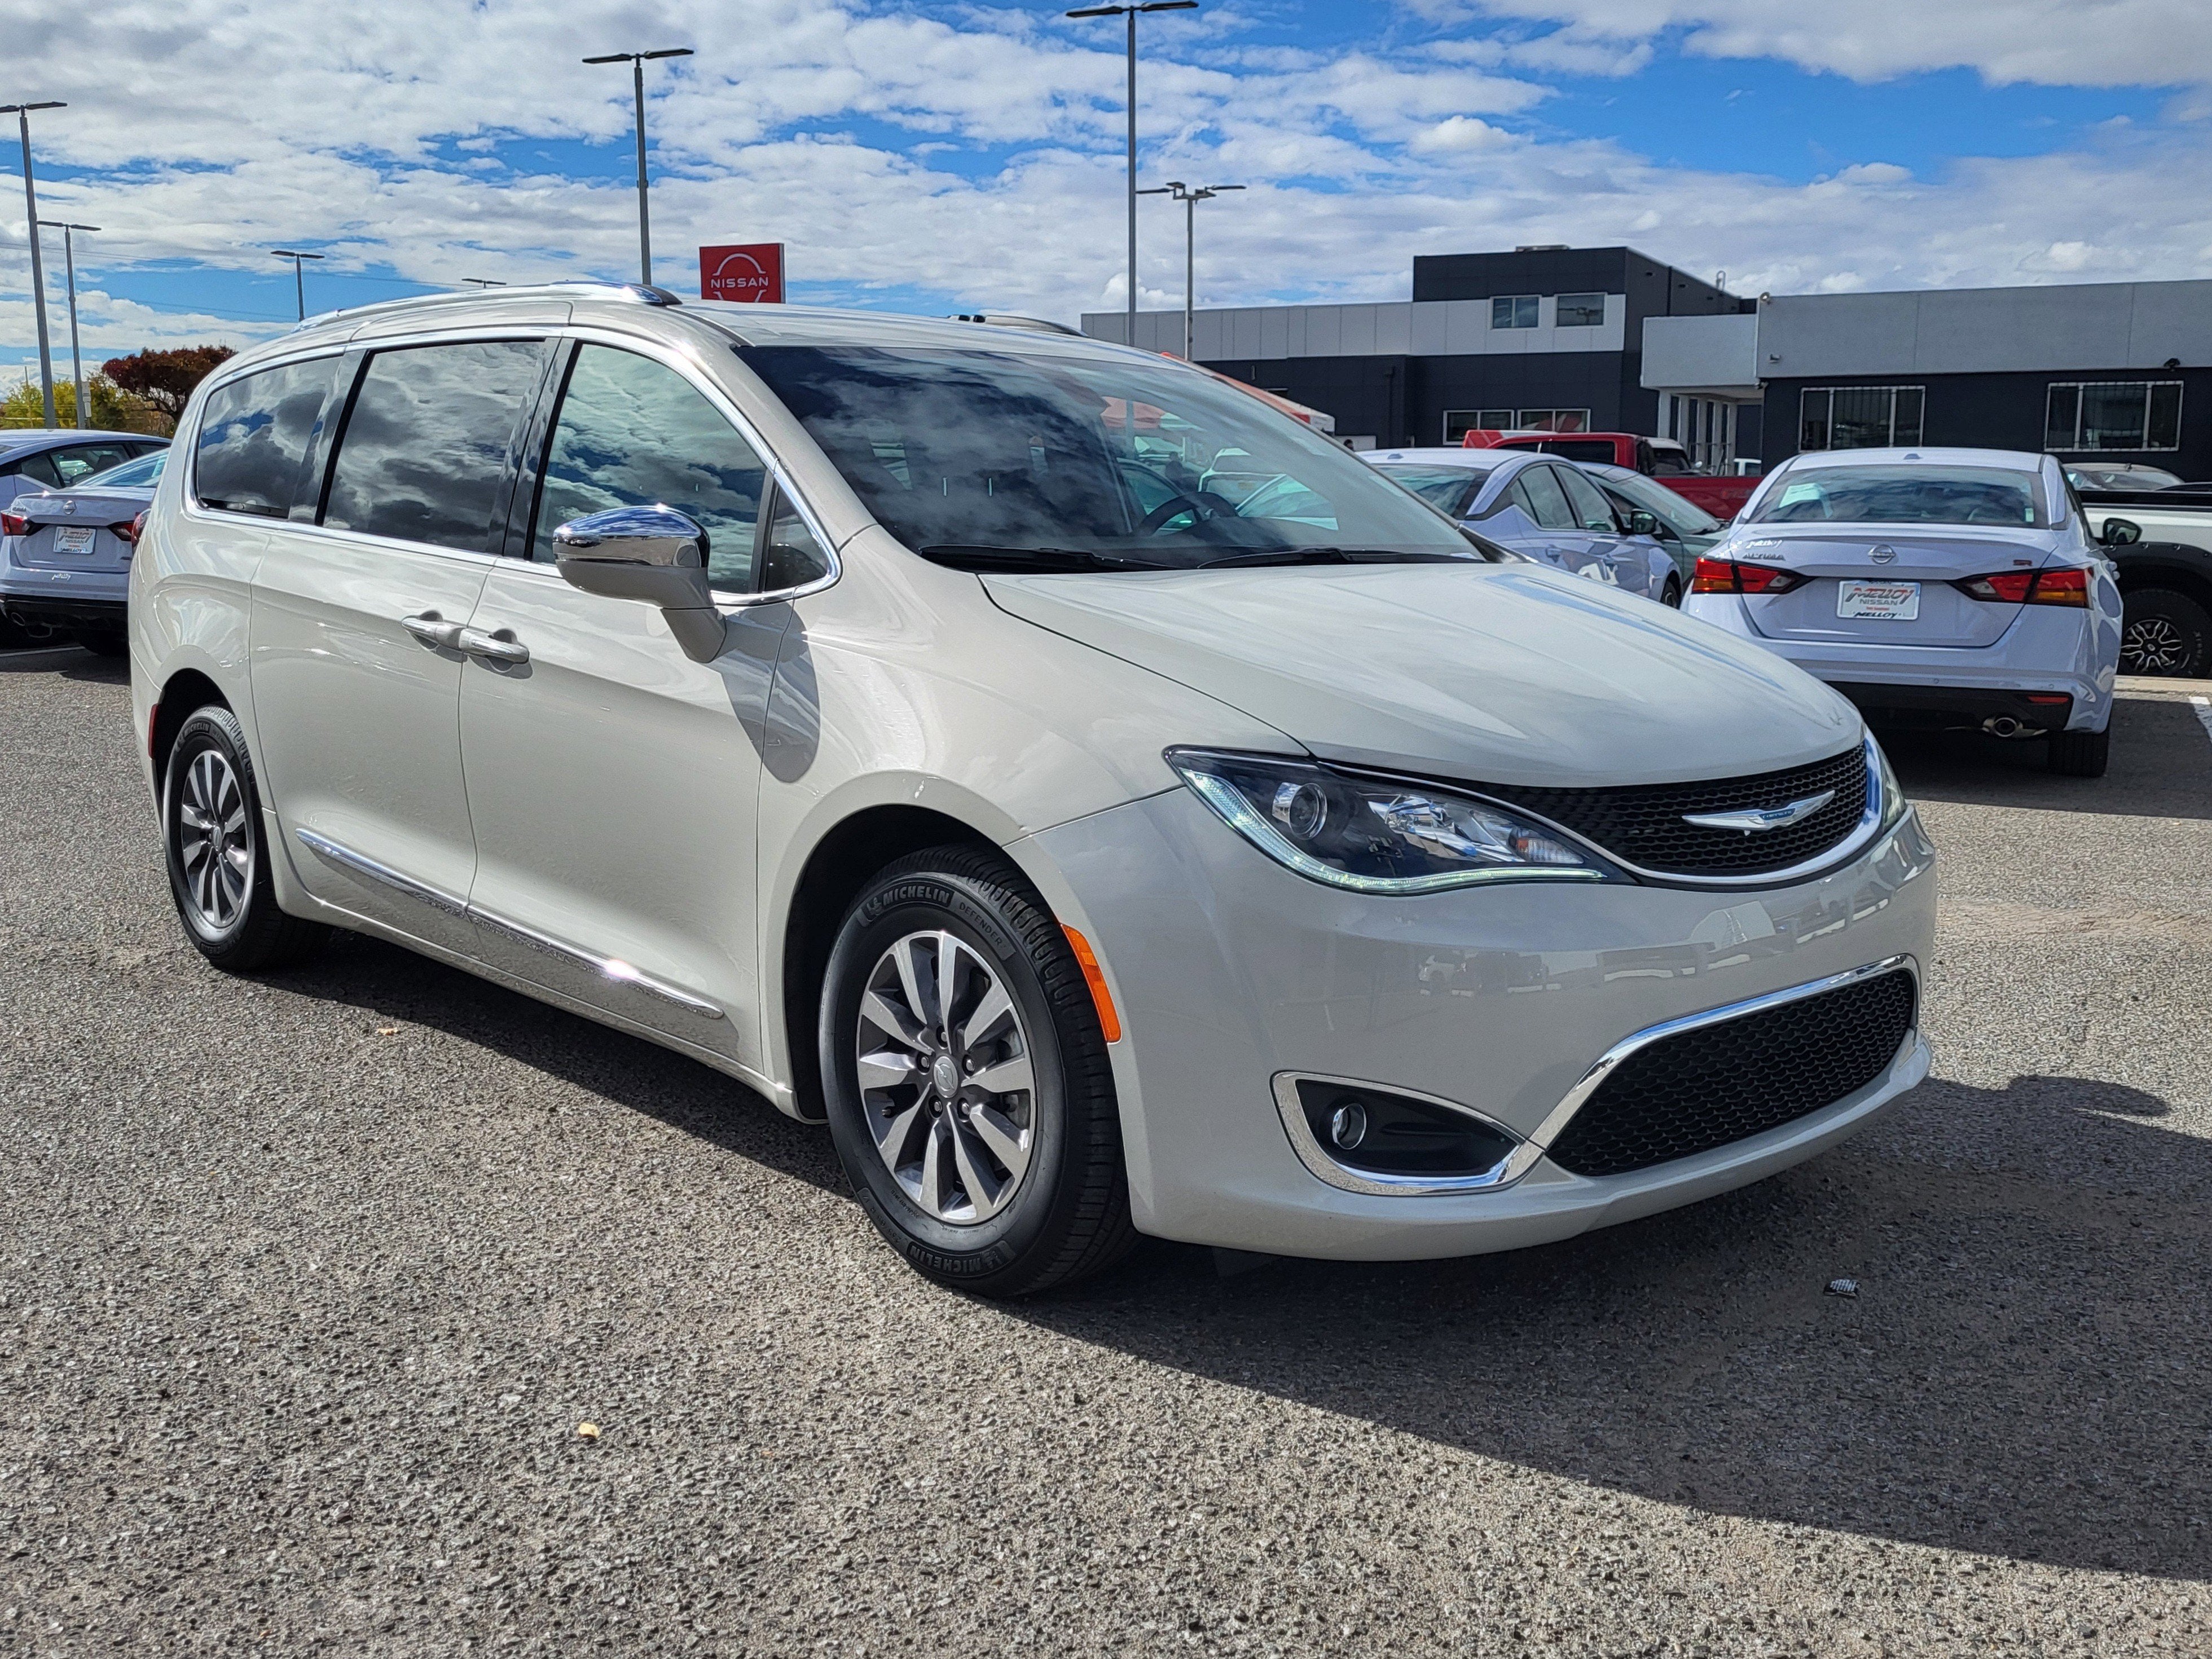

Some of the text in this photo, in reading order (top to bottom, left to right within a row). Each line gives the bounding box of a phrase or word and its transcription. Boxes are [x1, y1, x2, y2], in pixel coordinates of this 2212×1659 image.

[711, 276, 768, 288] NISSAN
[1845, 587, 1915, 605] MELLOY
[883, 885, 949, 906] MICHELIN
[959, 902, 1002, 946] DEFENDER
[909, 1244, 982, 1273] MICHELIN
